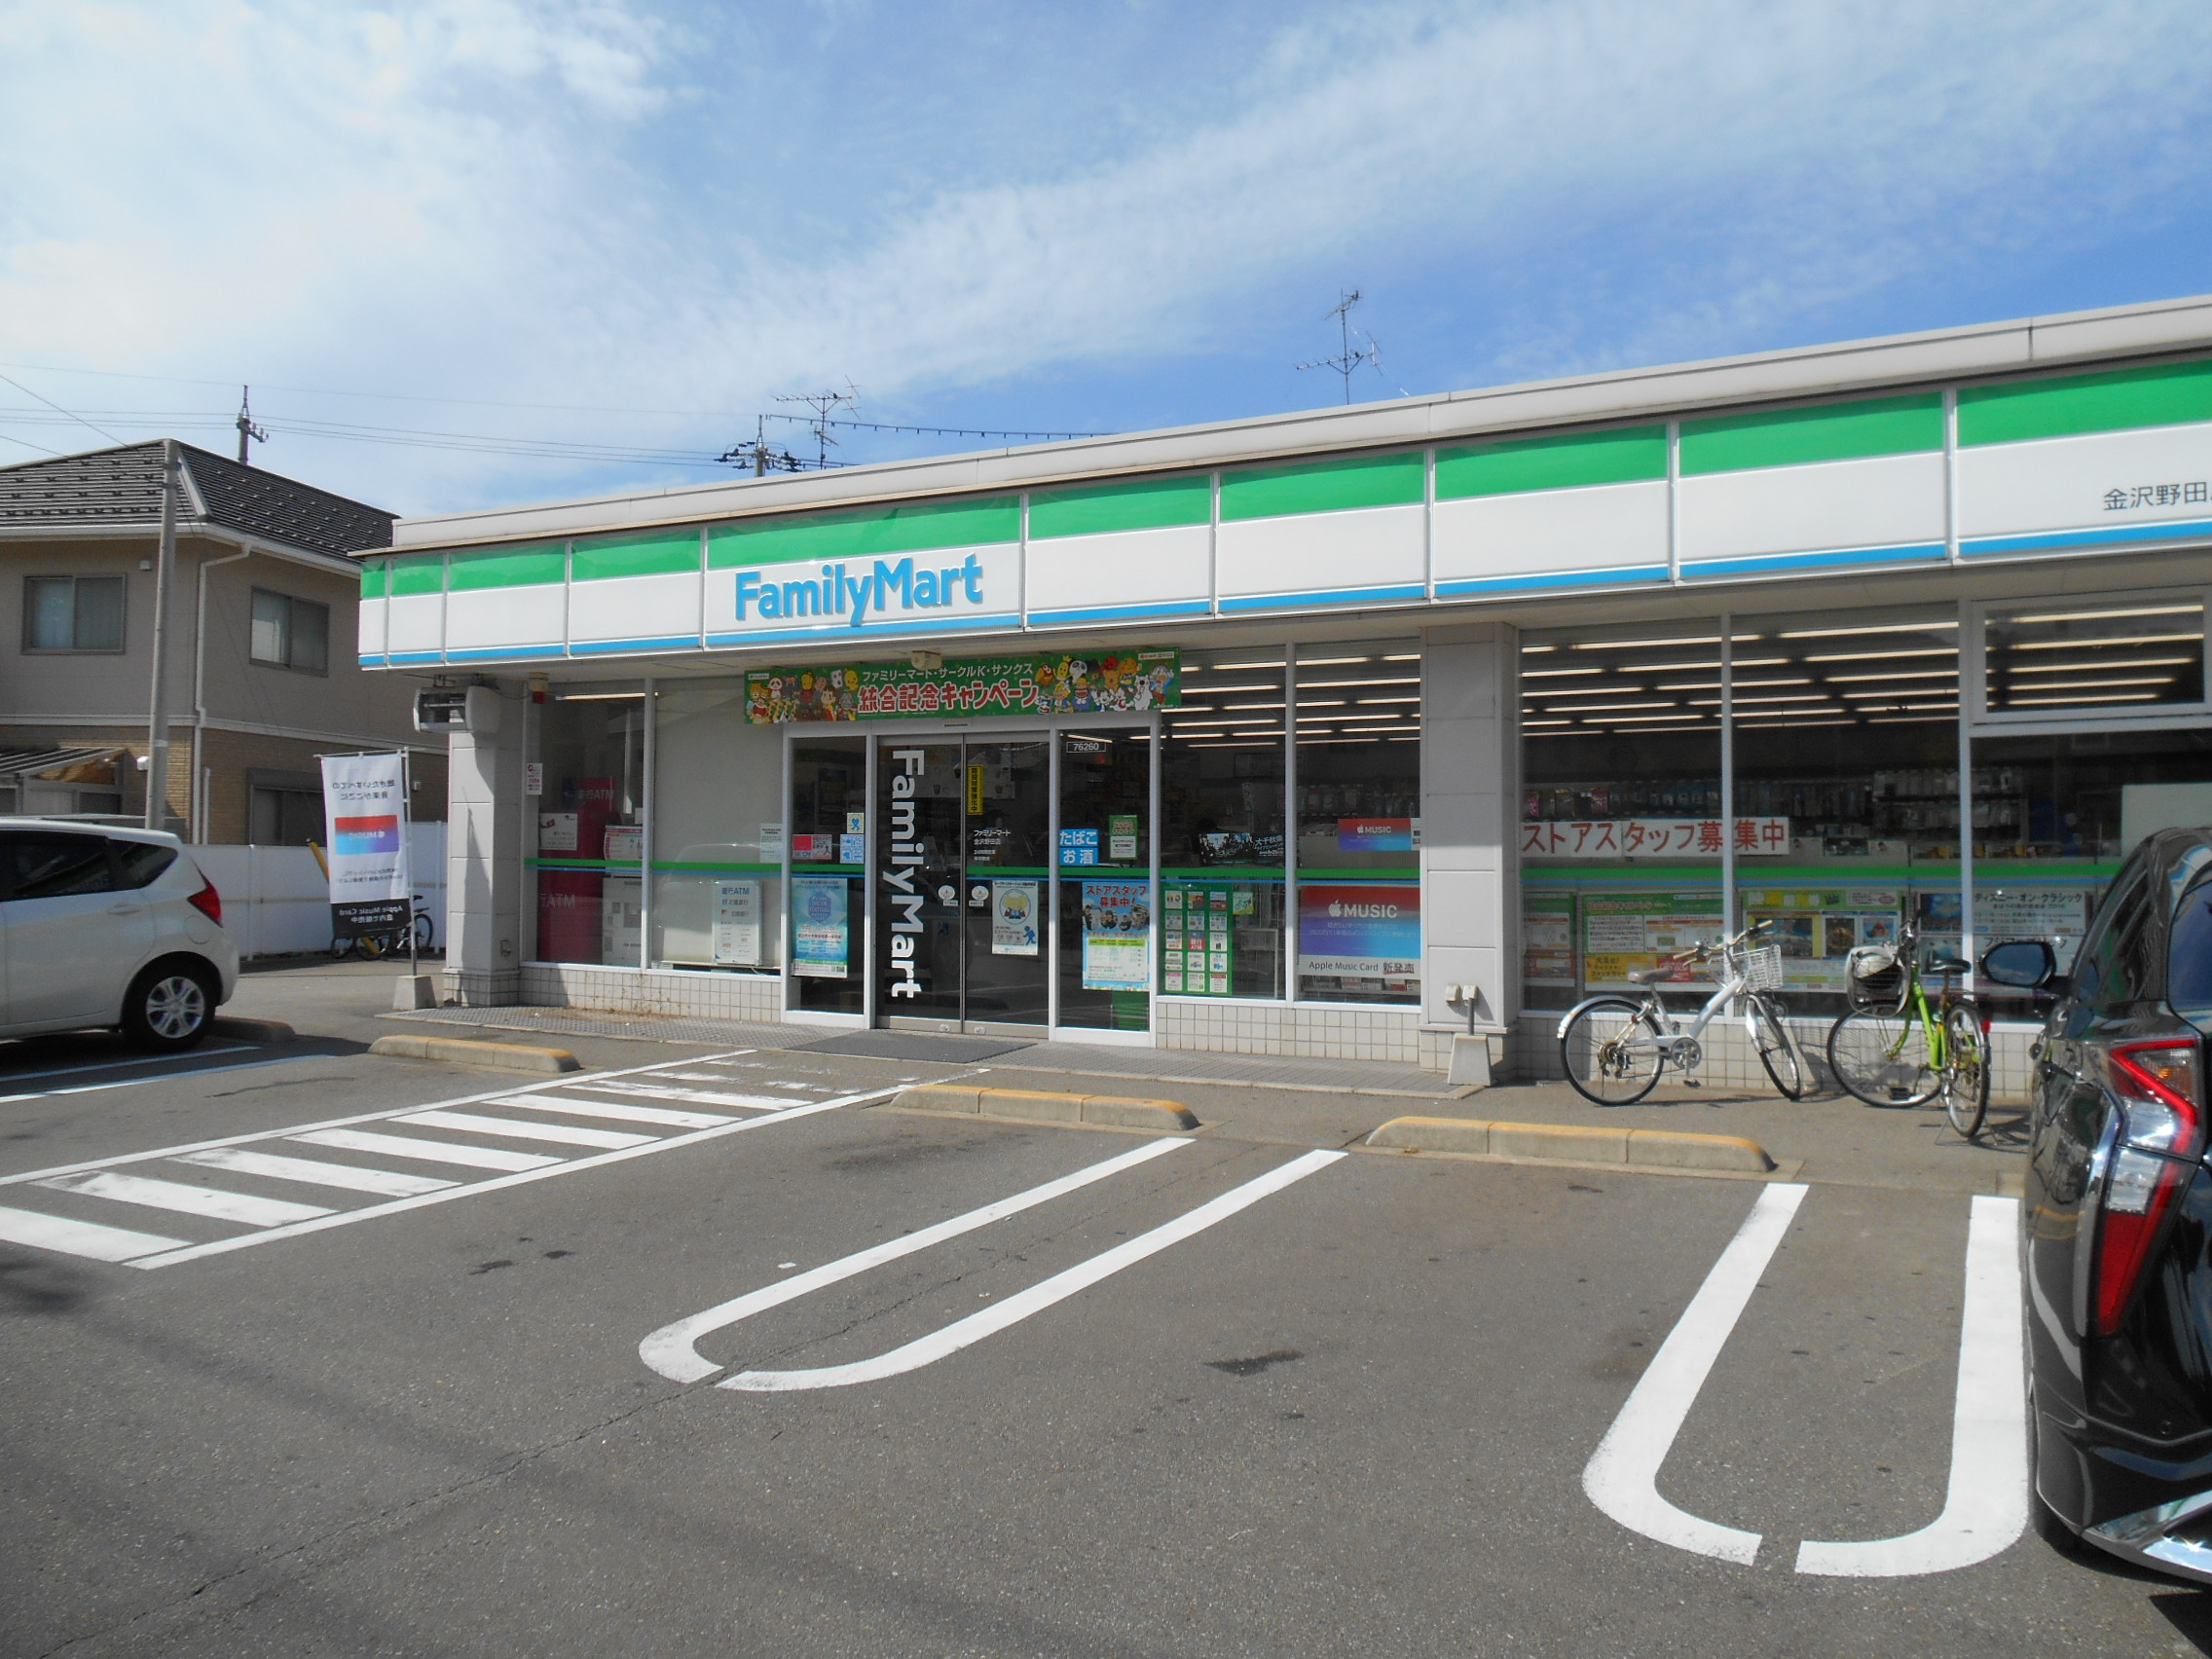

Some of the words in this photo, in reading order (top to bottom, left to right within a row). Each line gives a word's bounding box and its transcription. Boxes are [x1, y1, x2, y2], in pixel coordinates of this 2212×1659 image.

[2103, 482, 2212, 510] 金沢野田
[735, 553, 983, 627] FamilyMart
[858, 679, 1038, 713] 統合記念キャンペーン
[1059, 831, 1097, 845] たばこ
[1522, 821, 1785, 854] ストアスタッフ募集中
[882, 750, 925, 998] FamilyMart
[1087, 885, 1147, 896] ストアスタッフ
[1344, 903, 1397, 918] MUSIC
[1309, 961, 1333, 971] Apple
[1335, 962, 1357, 971] Music
[1359, 962, 1379, 972] Card
[1382, 962, 1415, 974] 新発売
